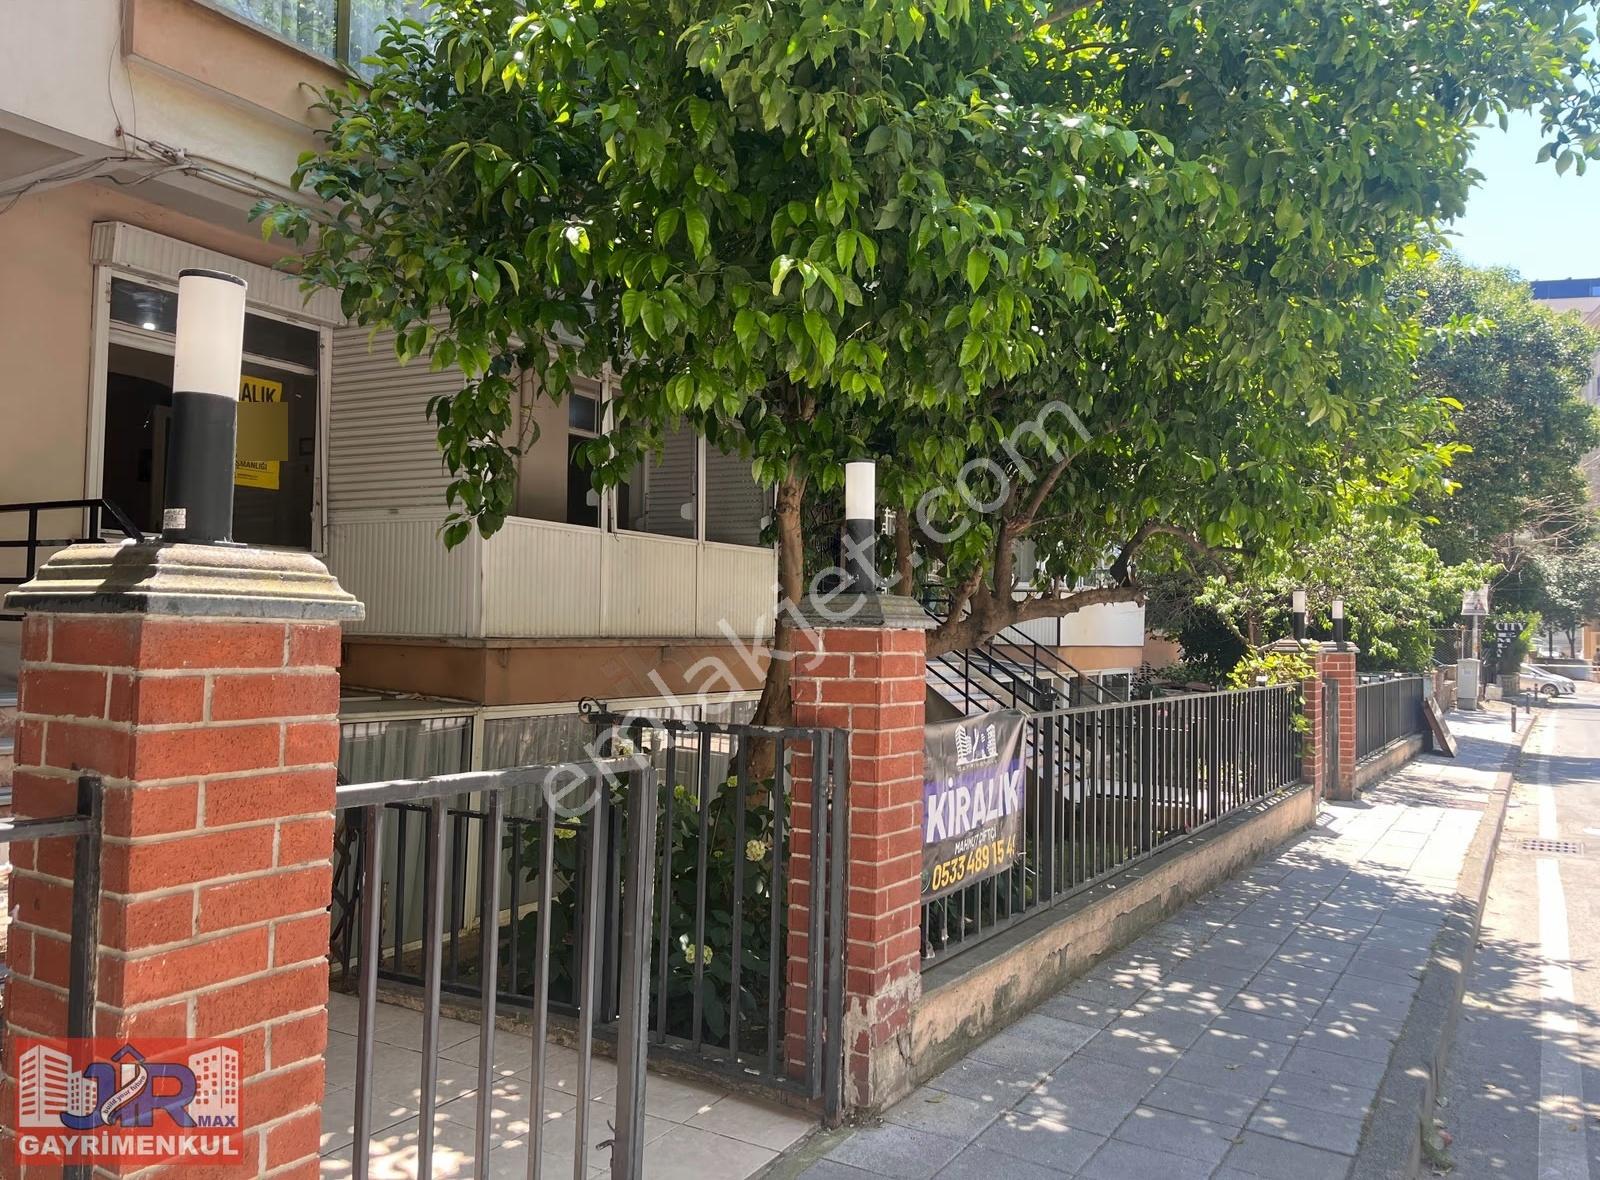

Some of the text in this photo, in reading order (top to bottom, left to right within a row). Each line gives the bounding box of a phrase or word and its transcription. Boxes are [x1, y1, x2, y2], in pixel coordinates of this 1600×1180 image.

[239, 382, 277, 402] ALIK
[1495, 622, 1527, 631] CITY
[926, 769, 1019, 843] KİRALIK
[932, 854, 966, 891] 0533
[966, 844, 990, 876] 489
[992, 839, 1005, 865] 15
